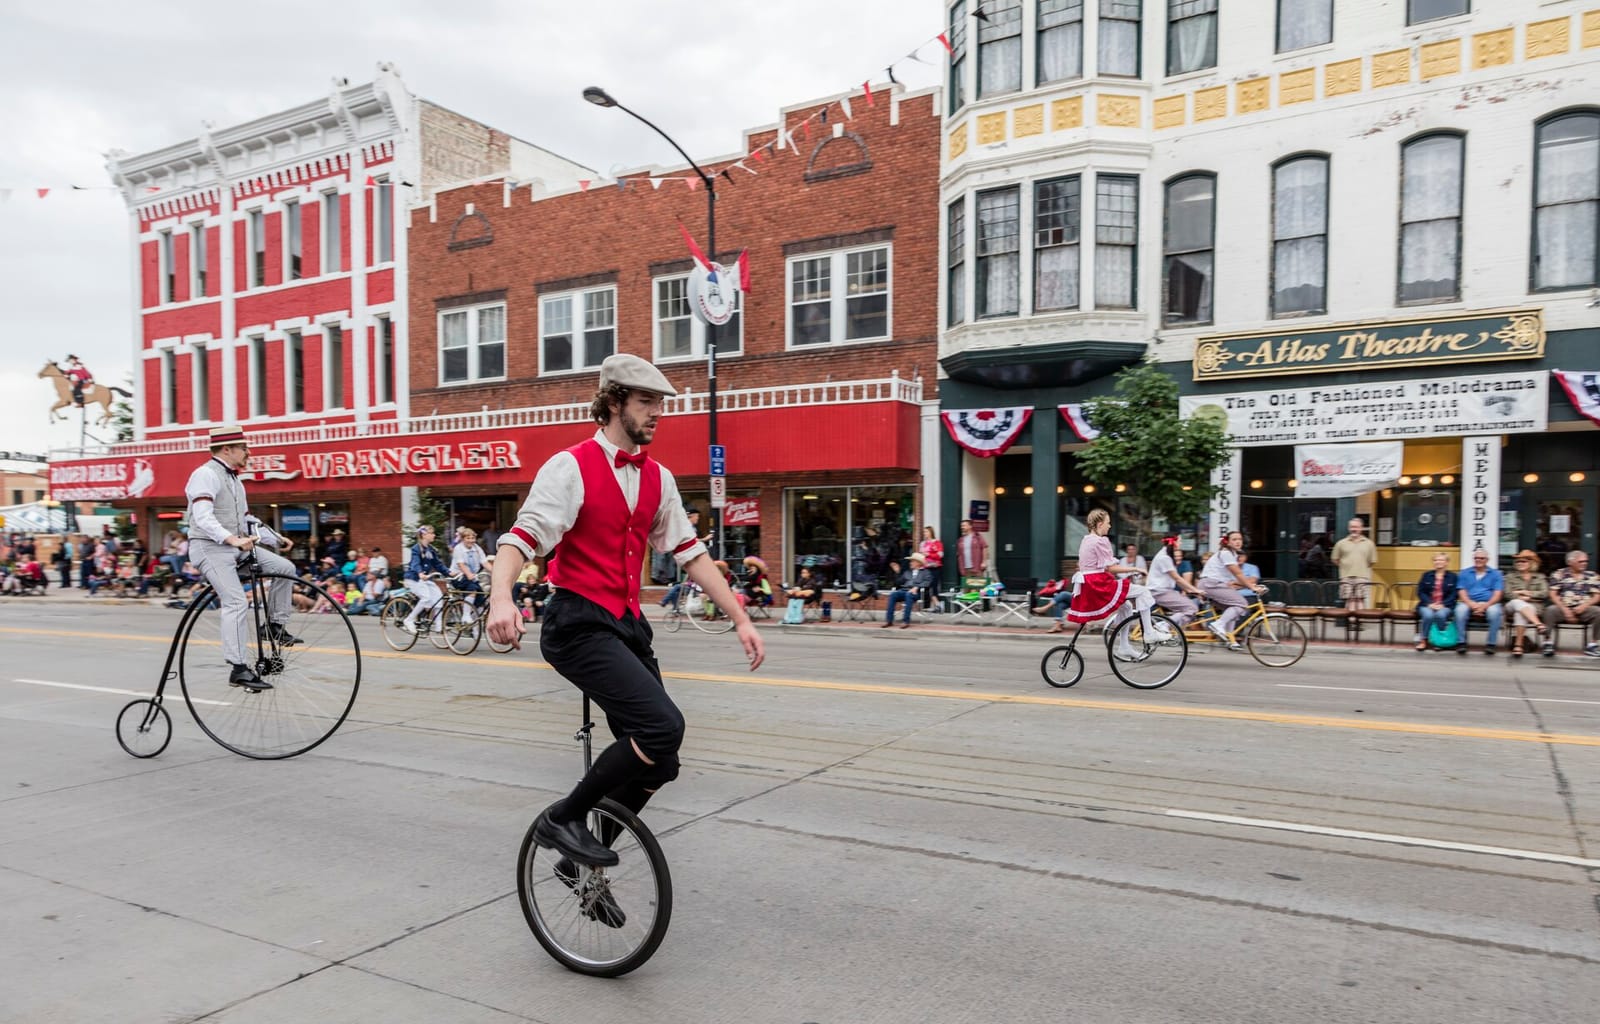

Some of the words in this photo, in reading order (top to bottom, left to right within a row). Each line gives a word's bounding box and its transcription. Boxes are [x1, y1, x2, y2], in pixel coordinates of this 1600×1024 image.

[1237, 340, 1331, 366] Atlas
[1337, 329, 1489, 360] Theatre
[1225, 398, 1256, 409] The
[1269, 393, 1297, 406] Old
[1311, 385, 1405, 403] Fashioned
[1420, 378, 1536, 396] Melodrama
[1230, 433, 1297, 442] ELEBRATING
[299, 440, 521, 478] WRANGLER
[1472, 442, 1489, 552] MELODRA
